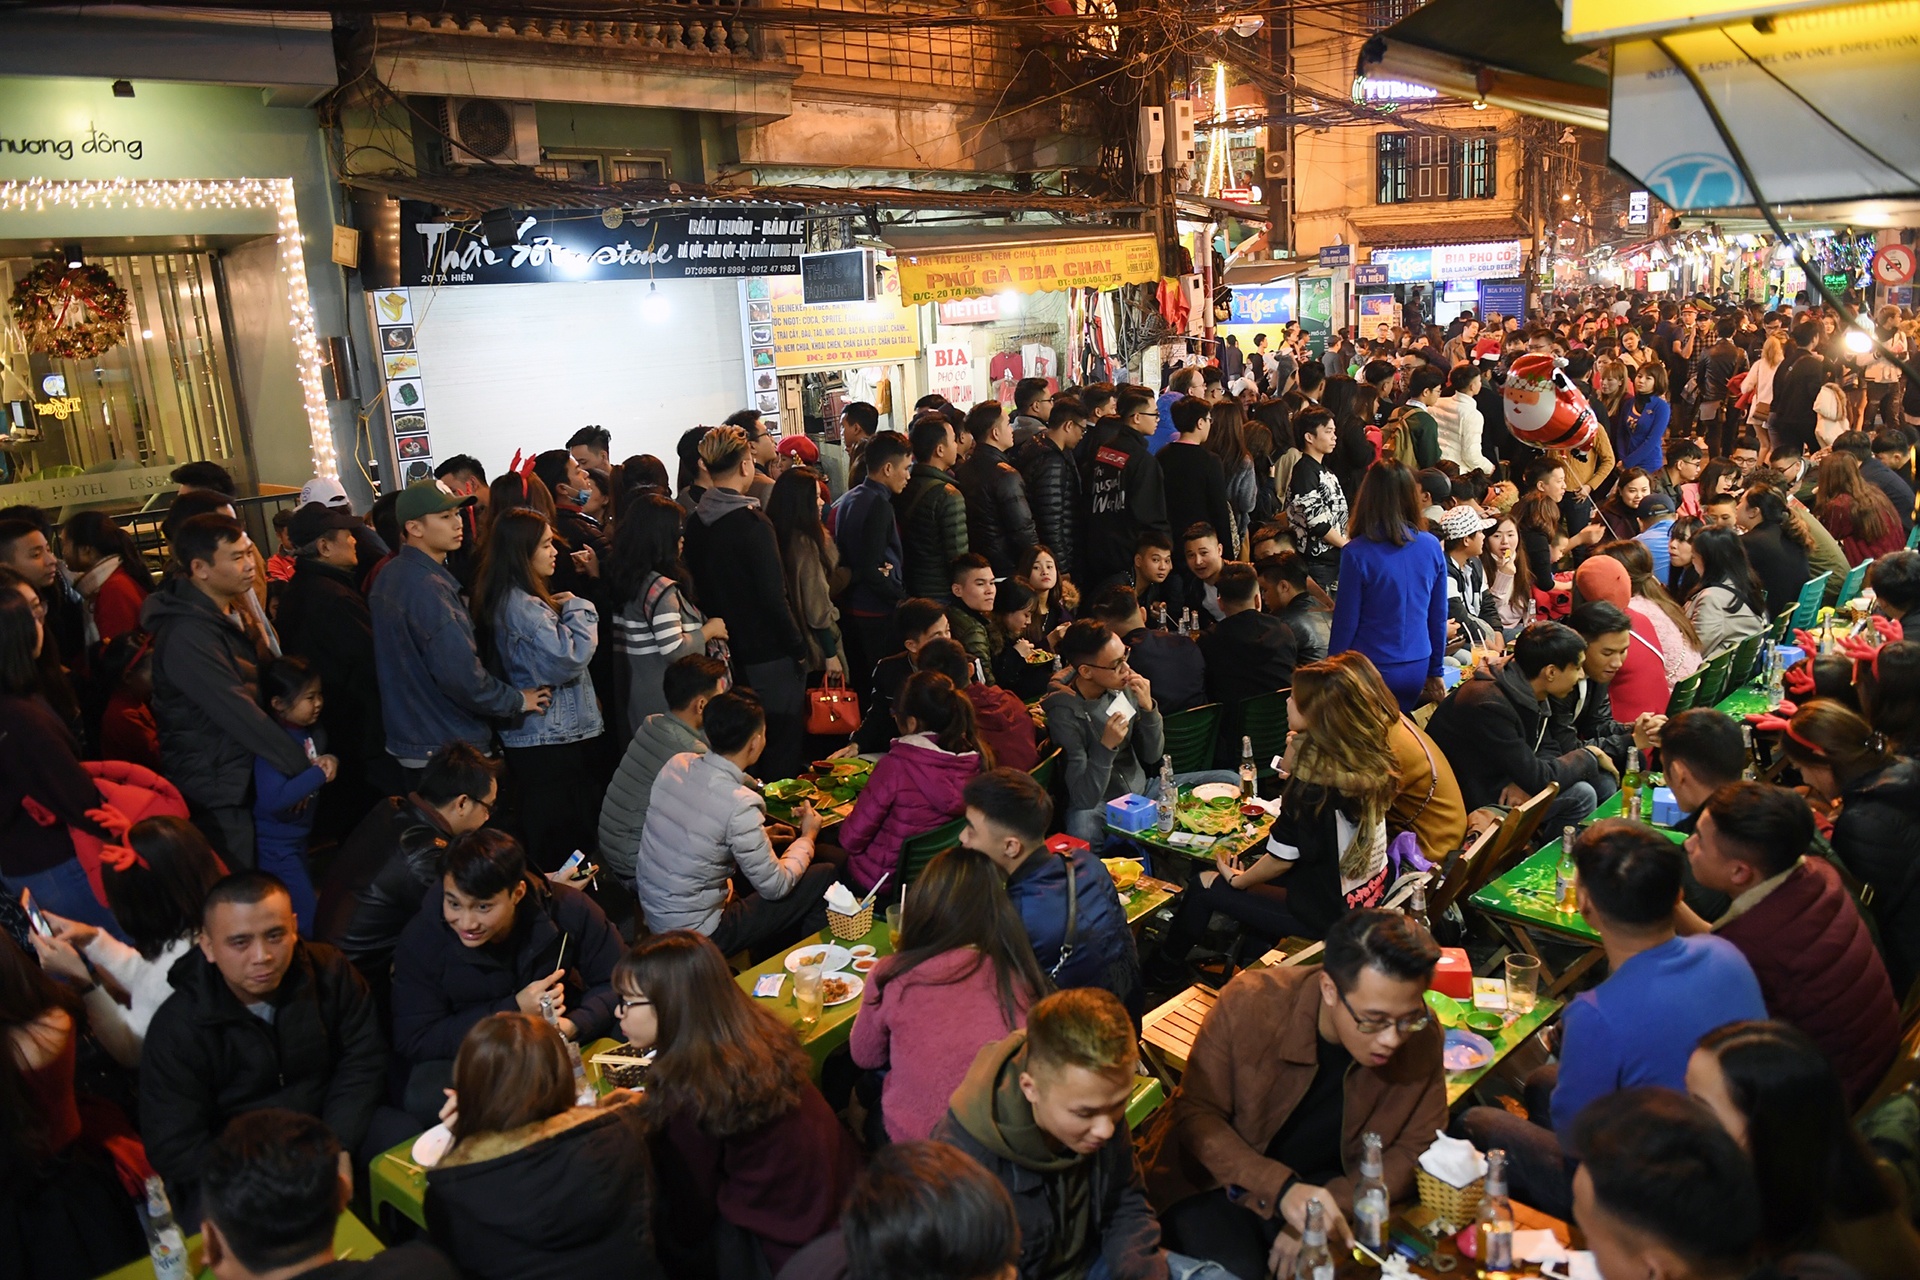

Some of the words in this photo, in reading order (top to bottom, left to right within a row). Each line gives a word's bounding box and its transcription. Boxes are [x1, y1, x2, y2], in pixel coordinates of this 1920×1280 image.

[1782, 49, 1803, 61] ON
[1806, 46, 1835, 58] ONE
[718, 216, 754, 235] BUÔN
[591, 240, 673, 269] stone
[1445, 253, 1465, 264] BIA
[719, 265, 726, 274] 11
[727, 265, 746, 274] 8998
[751, 265, 768, 273] 0912
[769, 265, 779, 273] 47
[780, 264, 796, 273] 1983
[926, 265, 977, 290] PHỞ
[981, 265, 1012, 285] GÀ
[1018, 264, 1057, 281] BIA
[1063, 259, 1112, 277] CHAI
[1389, 256, 1430, 279] Tiger
[1478, 264, 1495, 272] COLD
[421, 274, 433, 283] 20
[1358, 275, 1367, 284] TẠ
[1368, 273, 1384, 284] HIỆN
[937, 289, 948, 298] 20
[950, 287, 962, 298] TẠ
[943, 299, 996, 318] VIETTEL
[1237, 292, 1279, 322] Tiger
[826, 352, 838, 360] 20
[935, 348, 969, 367] BIA
